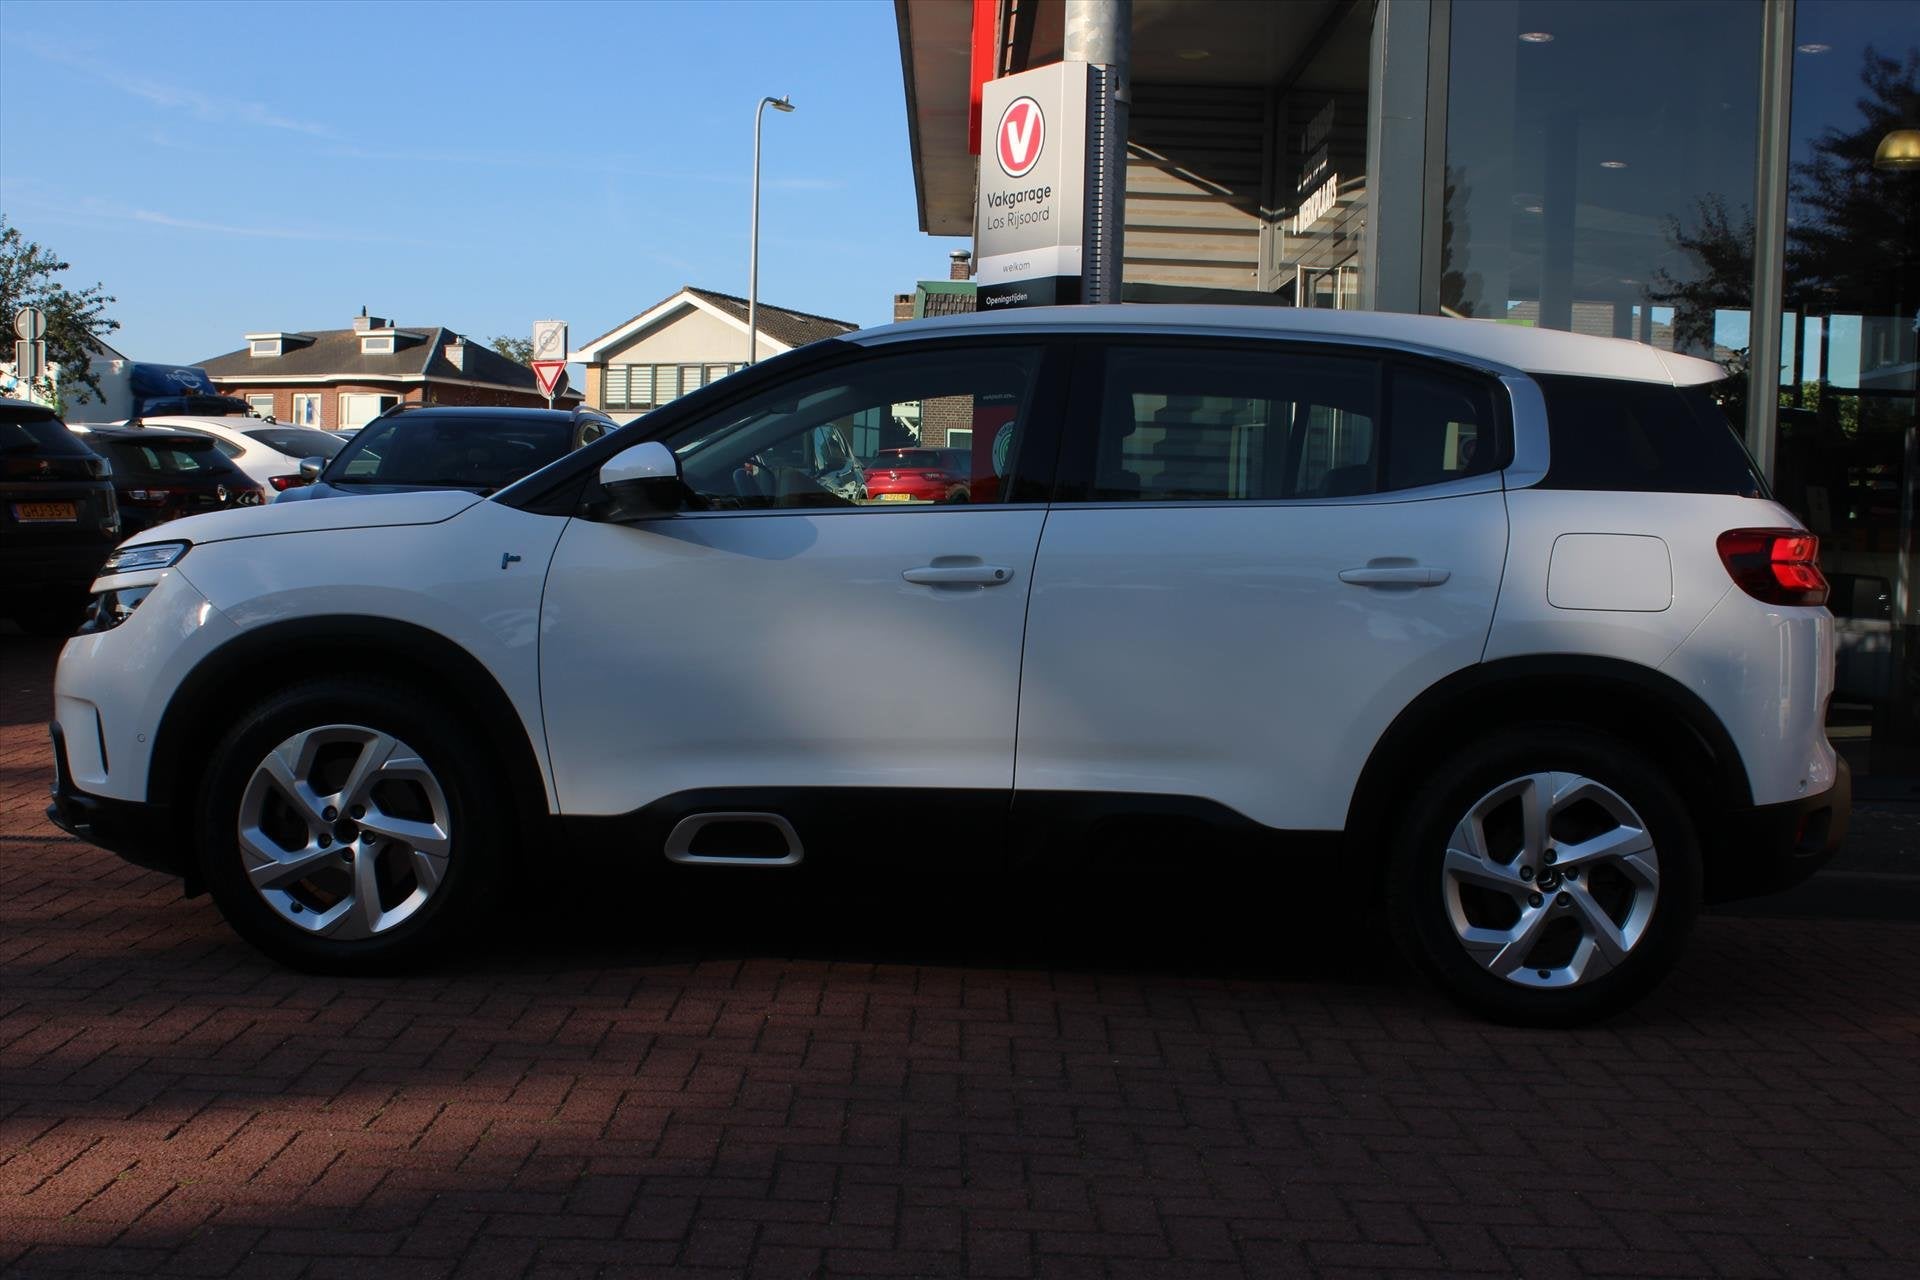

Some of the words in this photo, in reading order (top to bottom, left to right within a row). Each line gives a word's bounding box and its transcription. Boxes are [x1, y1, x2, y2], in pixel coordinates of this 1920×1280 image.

[987, 186, 1052, 209] Vakgarage
[987, 216, 1005, 230] Los
[1007, 206, 1050, 230] Rijsoord
[1002, 261, 1031, 273] welkom
[985, 293, 1028, 306] Openingstijden
